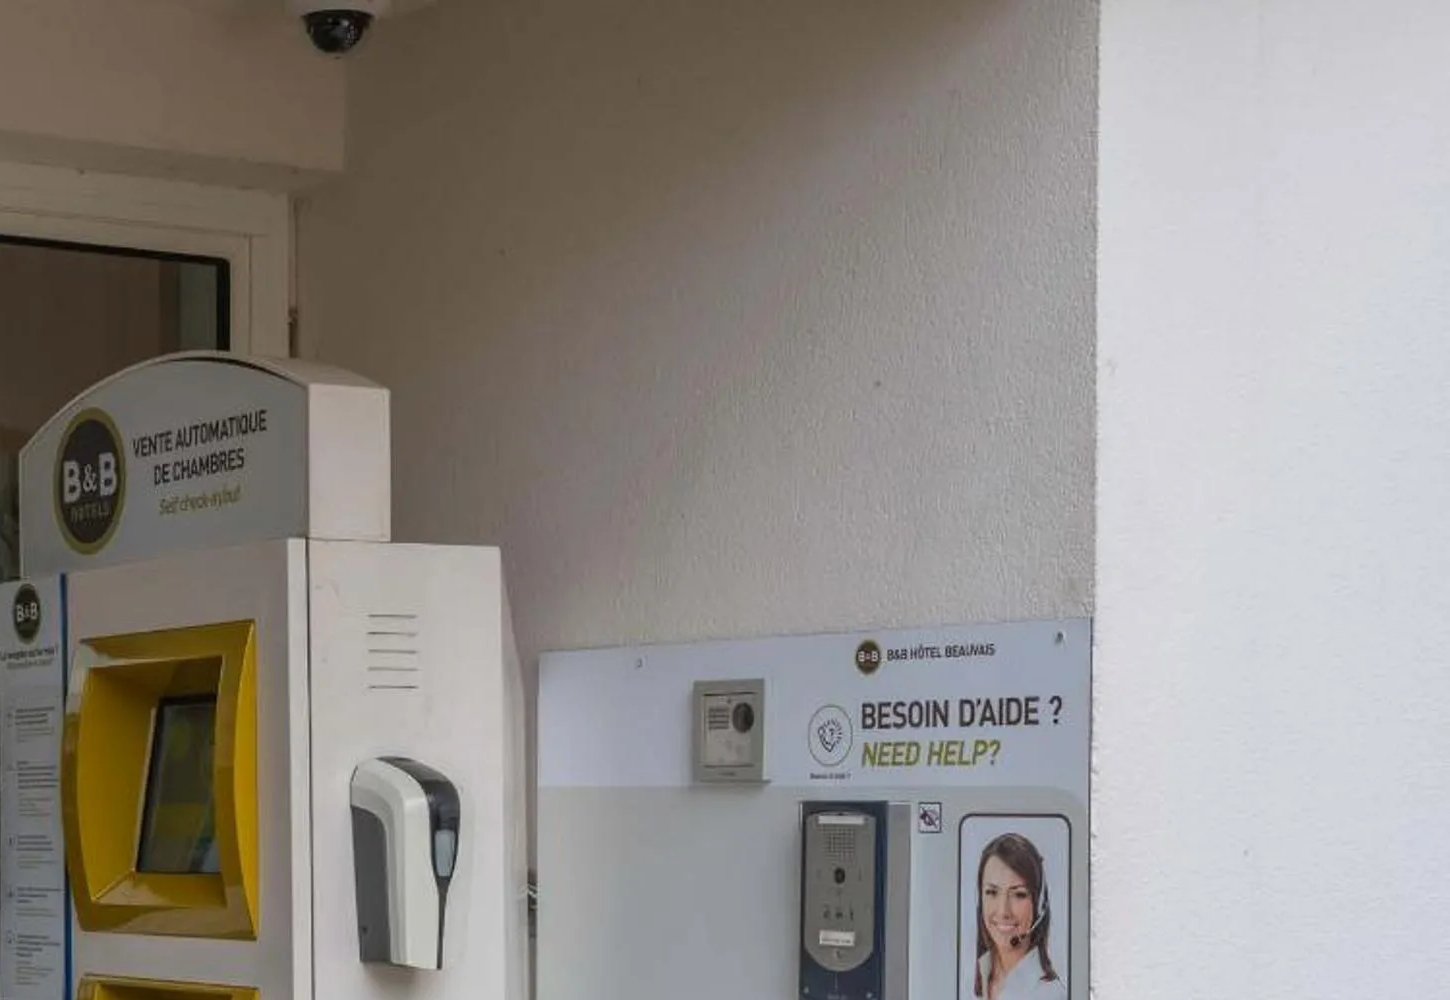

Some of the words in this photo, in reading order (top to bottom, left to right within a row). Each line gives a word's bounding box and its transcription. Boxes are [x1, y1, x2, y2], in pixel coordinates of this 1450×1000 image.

[133, 430, 172, 457] VENTE
[175, 409, 267, 450] AUTOMATIQUE
[64, 452, 117, 503] B&B
[154, 463, 171, 485] DE
[172, 448, 245, 481] CHAMBRES
[16, 602, 38, 622] B&B
[886, 648, 908, 662] B&B
[910, 643, 942, 660] HÔTEL
[945, 643, 996, 658] BEAUVAIS
[861, 700, 949, 729] BESOIN
[958, 696, 1040, 728] D'AIDE
[1049, 695, 1063, 725] ?
[861, 741, 921, 767] NEED
[927, 739, 1002, 767] HELP?
